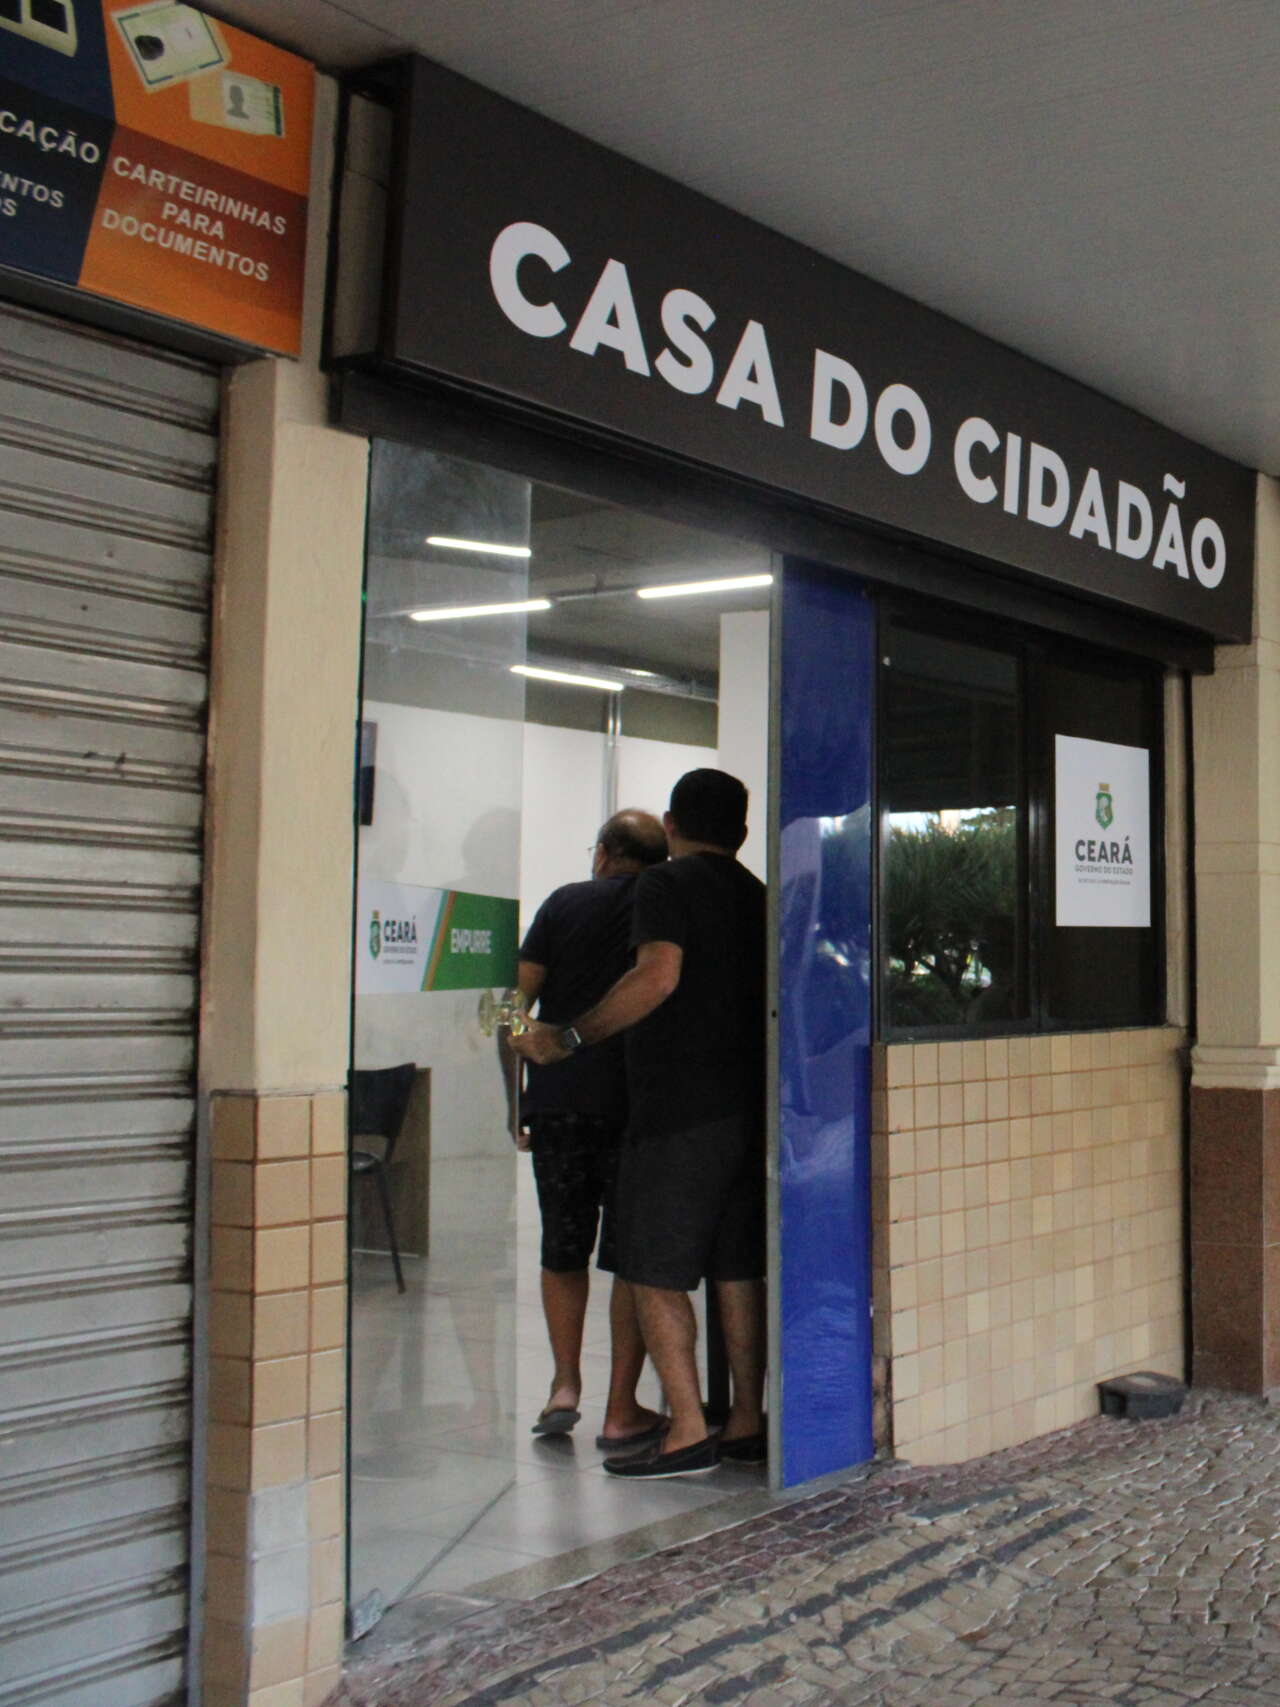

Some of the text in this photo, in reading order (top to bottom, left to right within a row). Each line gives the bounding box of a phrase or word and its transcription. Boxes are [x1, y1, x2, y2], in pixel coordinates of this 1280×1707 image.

[0, 170, 64, 208] NTOS
[113, 156, 287, 235] CARTEIRINHAS
[162, 202, 225, 240] PARA
[102, 209, 270, 281] DOCUMENTOS
[489, 221, 1227, 589] CASA DO CIDADÃO
[1074, 835, 1133, 865] CEARÁ
[384, 914, 417, 943] CEARÁ
